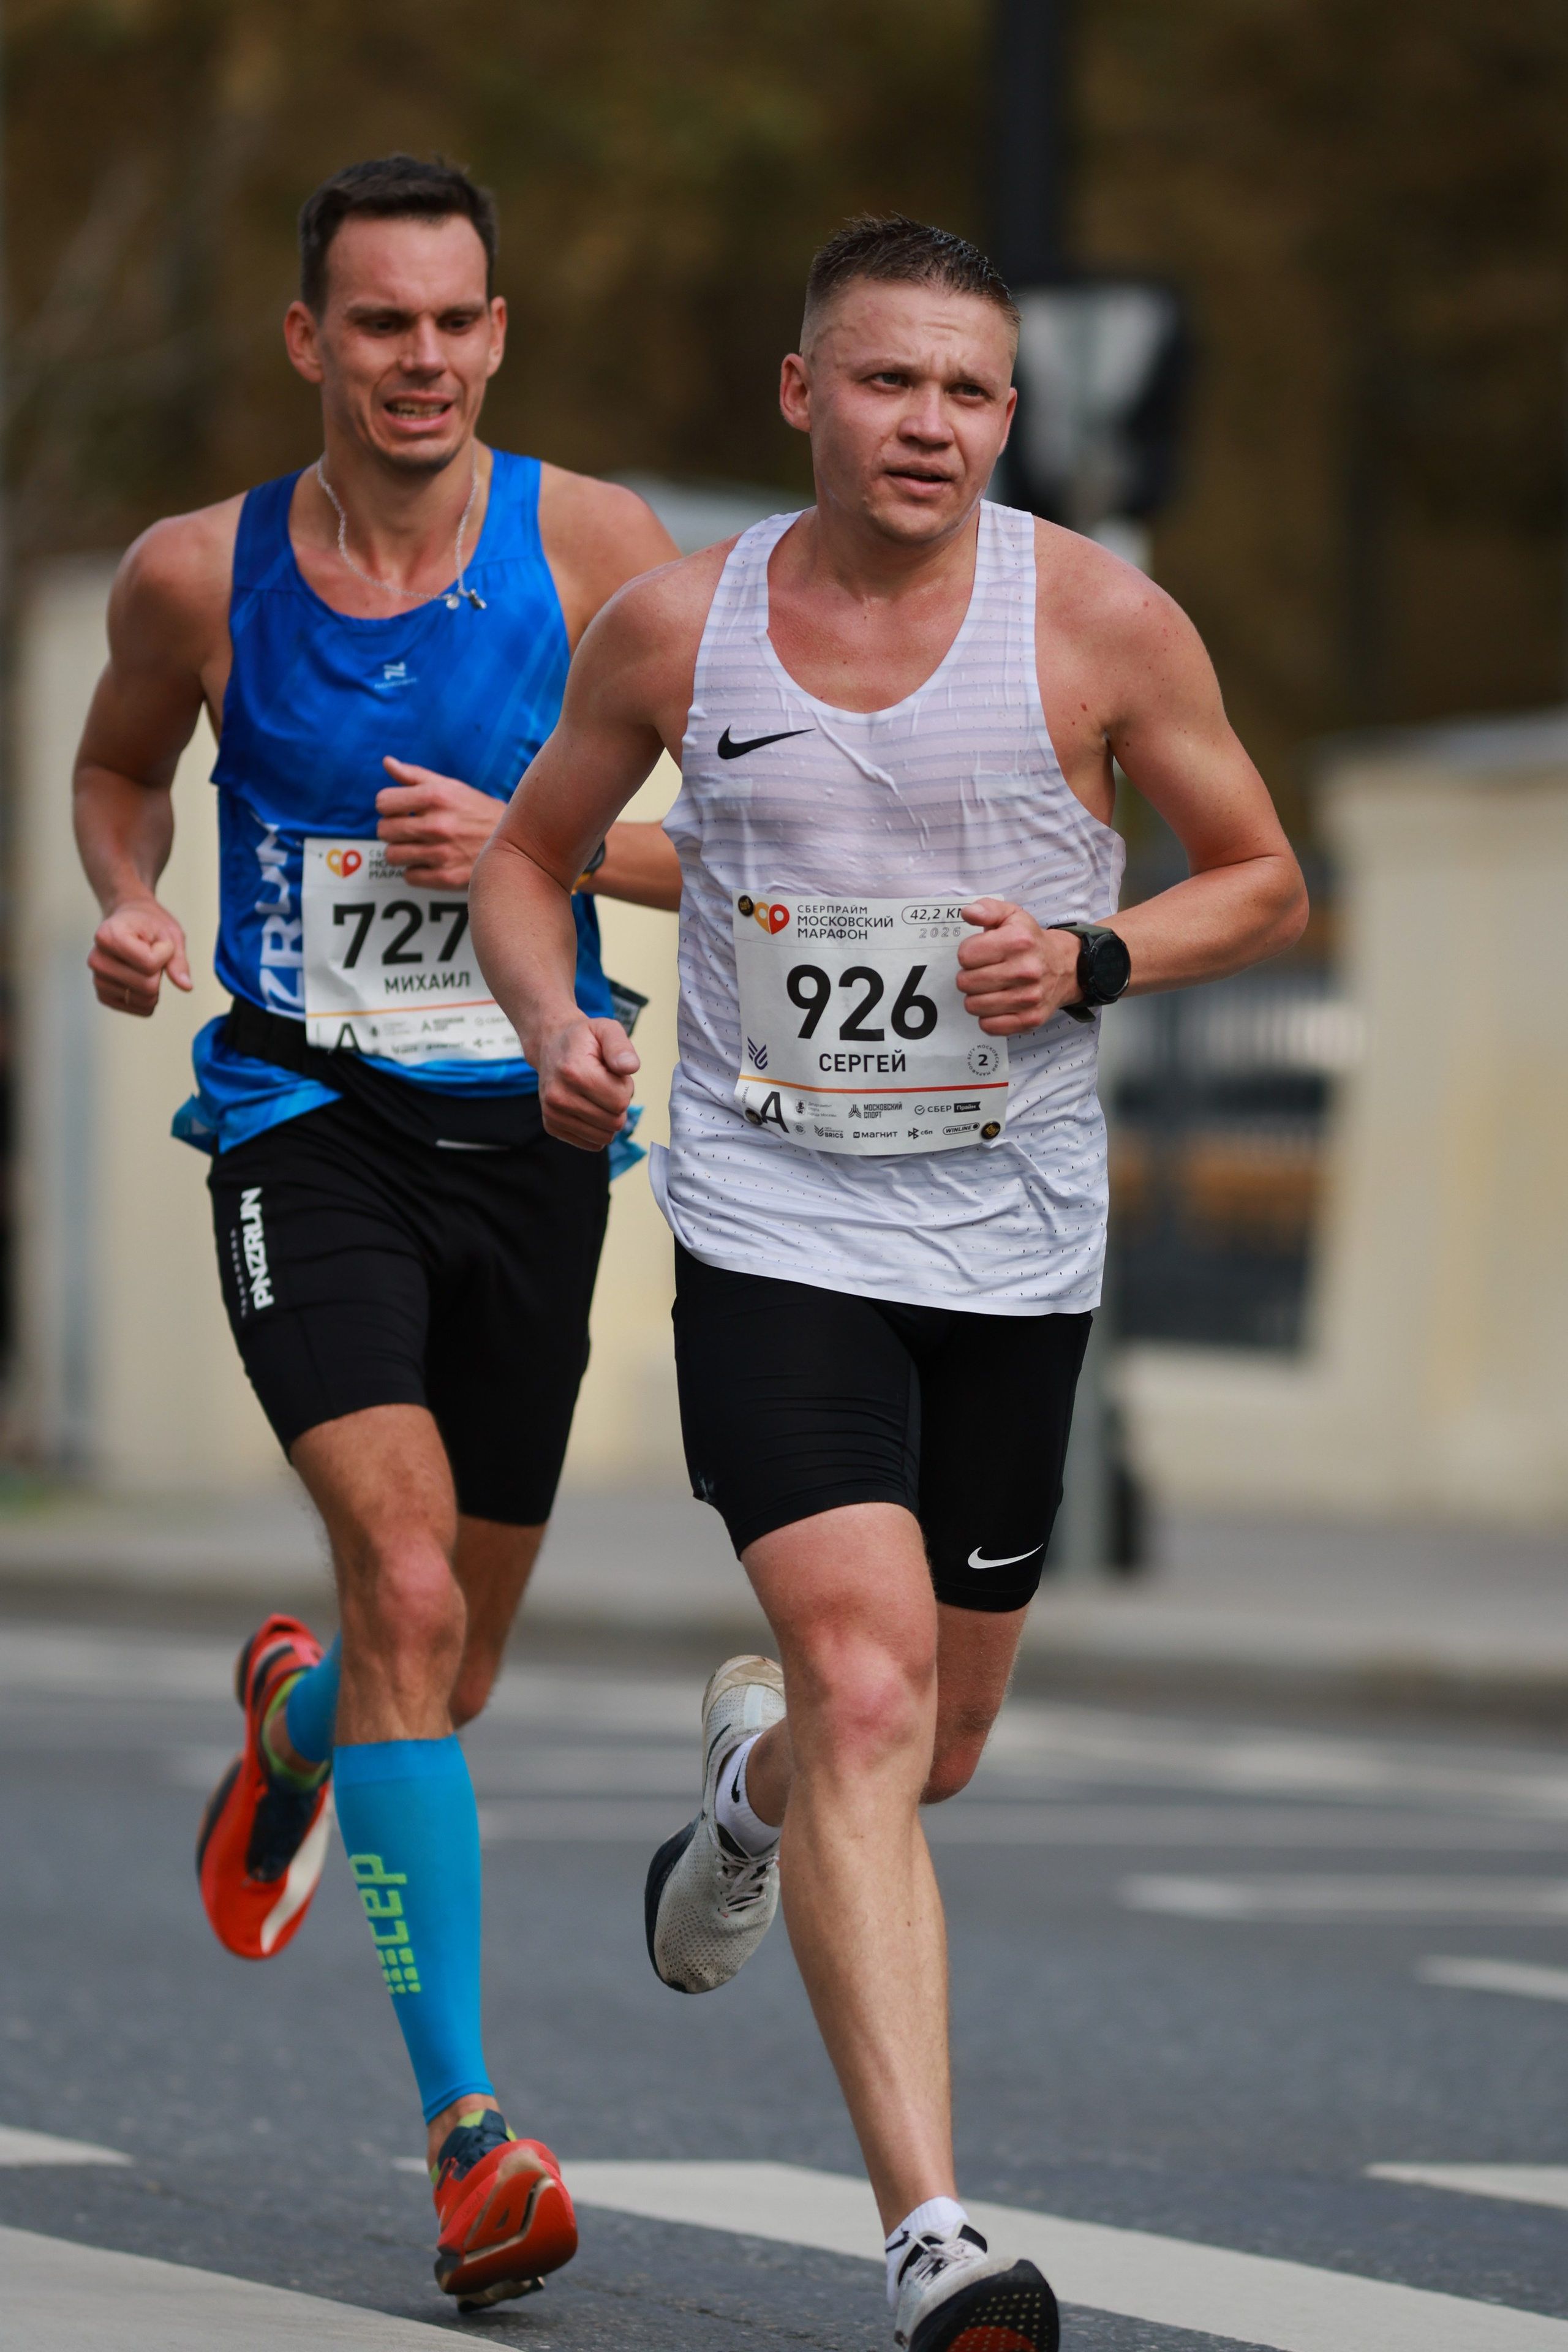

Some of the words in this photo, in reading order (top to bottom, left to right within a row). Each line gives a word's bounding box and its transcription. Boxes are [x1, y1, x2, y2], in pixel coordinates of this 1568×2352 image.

[797, 905, 867, 914] СБЕРПРАЙМ
[910, 908, 940, 921] 42,2
[253, 815, 306, 1022] ZRUN
[797, 916, 893, 927] МОСКОВСКИЙ
[333, 900, 469, 969] 727
[797, 929, 867, 940] МАРАФОН
[384, 971, 470, 994] МИХАИЛ
[786, 964, 937, 1041] 926
[819, 1049, 906, 1072] СЕРГЕЙ
[977, 1044, 999, 1072] МОСКОВСКИЙ
[978, 1054, 988, 1066] 2
[967, 1062, 990, 1076] МАРАФОН
[864, 1101, 902, 1110] МОСКОВСКИЙ
[946, 1125, 972, 1134] WINLINE
